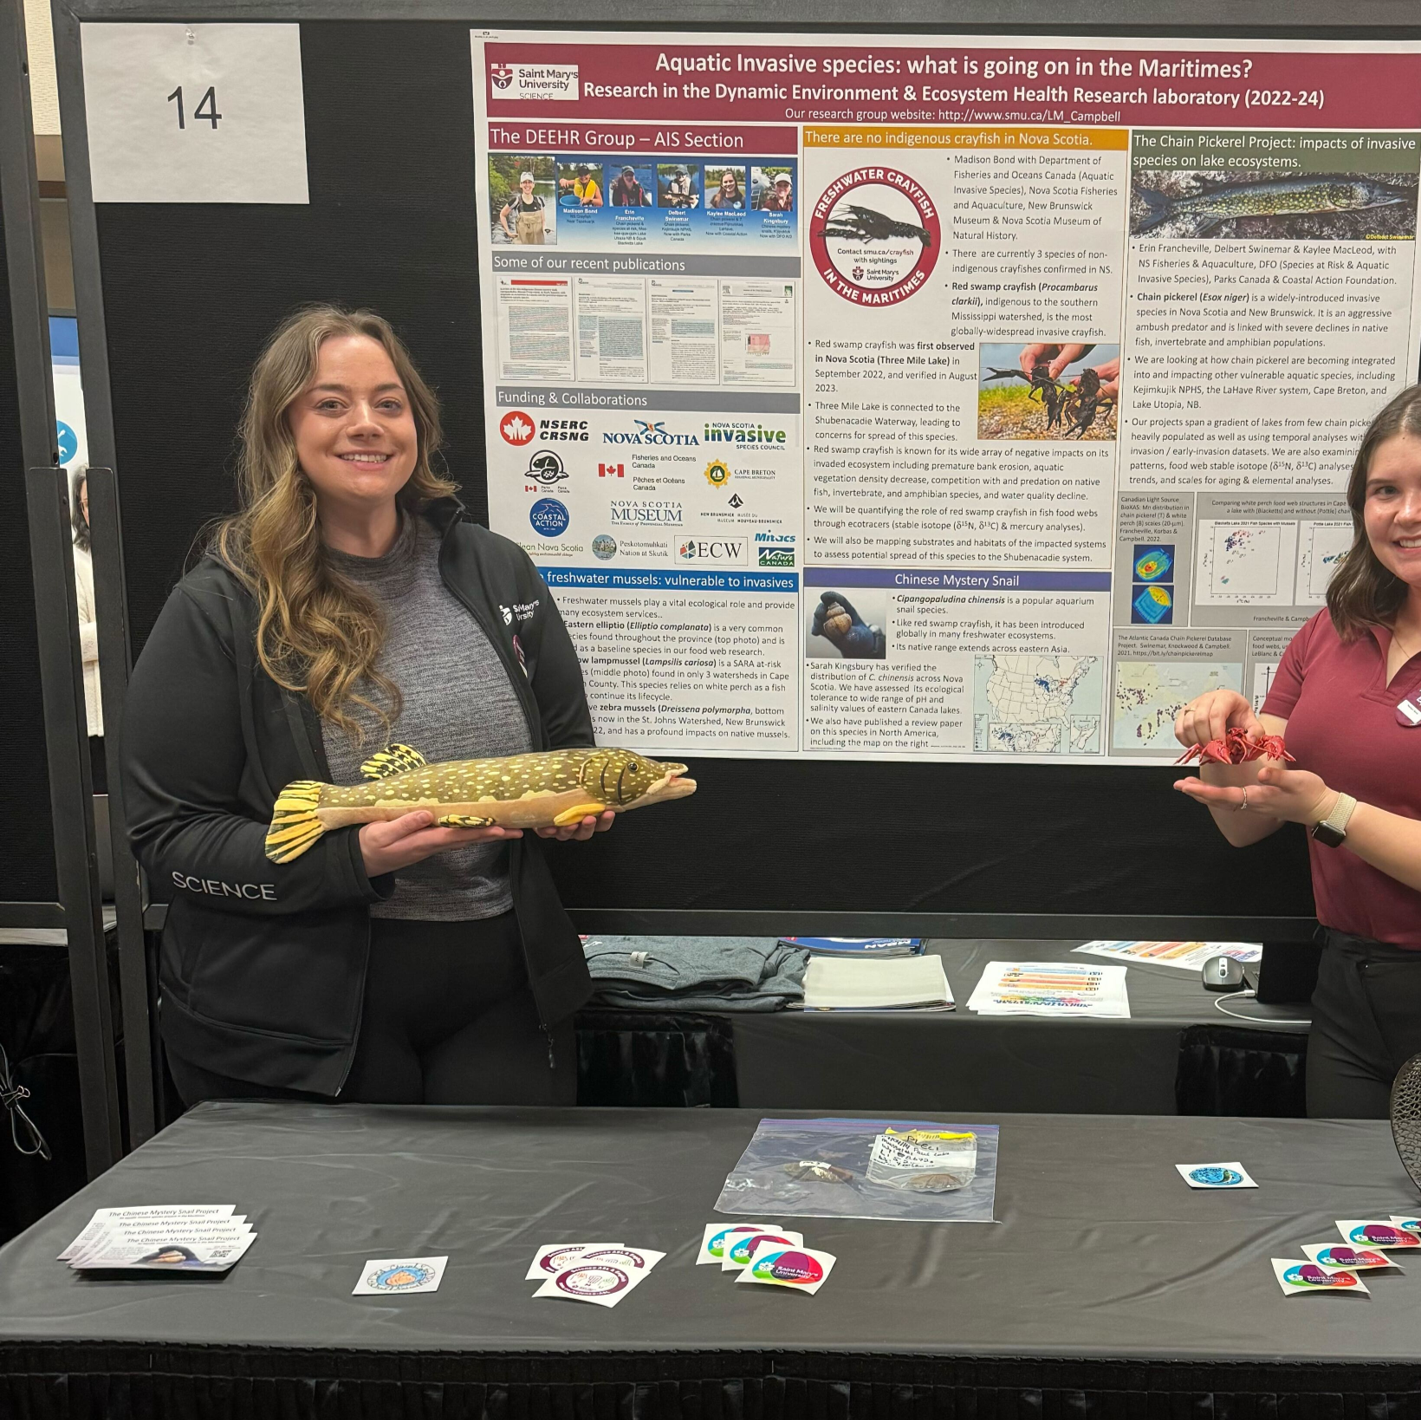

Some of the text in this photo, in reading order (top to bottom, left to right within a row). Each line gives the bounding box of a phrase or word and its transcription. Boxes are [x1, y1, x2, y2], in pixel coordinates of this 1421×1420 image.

[656, 53, 1252, 78] Aquatic Invasive species: what is going on in the Maritimes?
[519, 69, 579, 81] Saint Mary's
[519, 80, 569, 91] University
[584, 82, 1324, 109] Research in the Dynamic Environment & Ecosystem Health Research laboratory (2022-24)
[167, 86, 222, 129] 14
[785, 108, 1120, 123] Our research group website: http://www.smu.ca/LM_Campbell
[490, 129, 520, 146] The
[526, 129, 580, 144] DEEHR
[585, 130, 635, 149] Group
[654, 132, 679, 146] AIS
[685, 132, 743, 147] Section
[805, 131, 1092, 146] There are no indigenous crayfish in Nova Scotia.
[1134, 135, 1415, 151] The Chain Pickerel Project: impacts of invasive
[1133, 154, 1301, 169] species on lake ecosystems.
[494, 256, 685, 272] Some of our recent publications
[499, 391, 647, 406] Funding & Collaborations
[540, 420, 588, 430] NSERC
[540, 431, 589, 441] CRSNG
[603, 432, 699, 446] NOVA SCOTIA
[704, 424, 786, 443] invasive
[533, 513, 566, 521] COASTAL
[611, 508, 682, 521] MUSEUM
[754, 530, 796, 542] Mitacs
[697, 542, 741, 558] ECW
[547, 571, 793, 589] freshwater mussels: vulnerable to invasives
[895, 574, 1019, 588] Chinese Mystery Snail
[172, 871, 277, 900] SCIENCE
